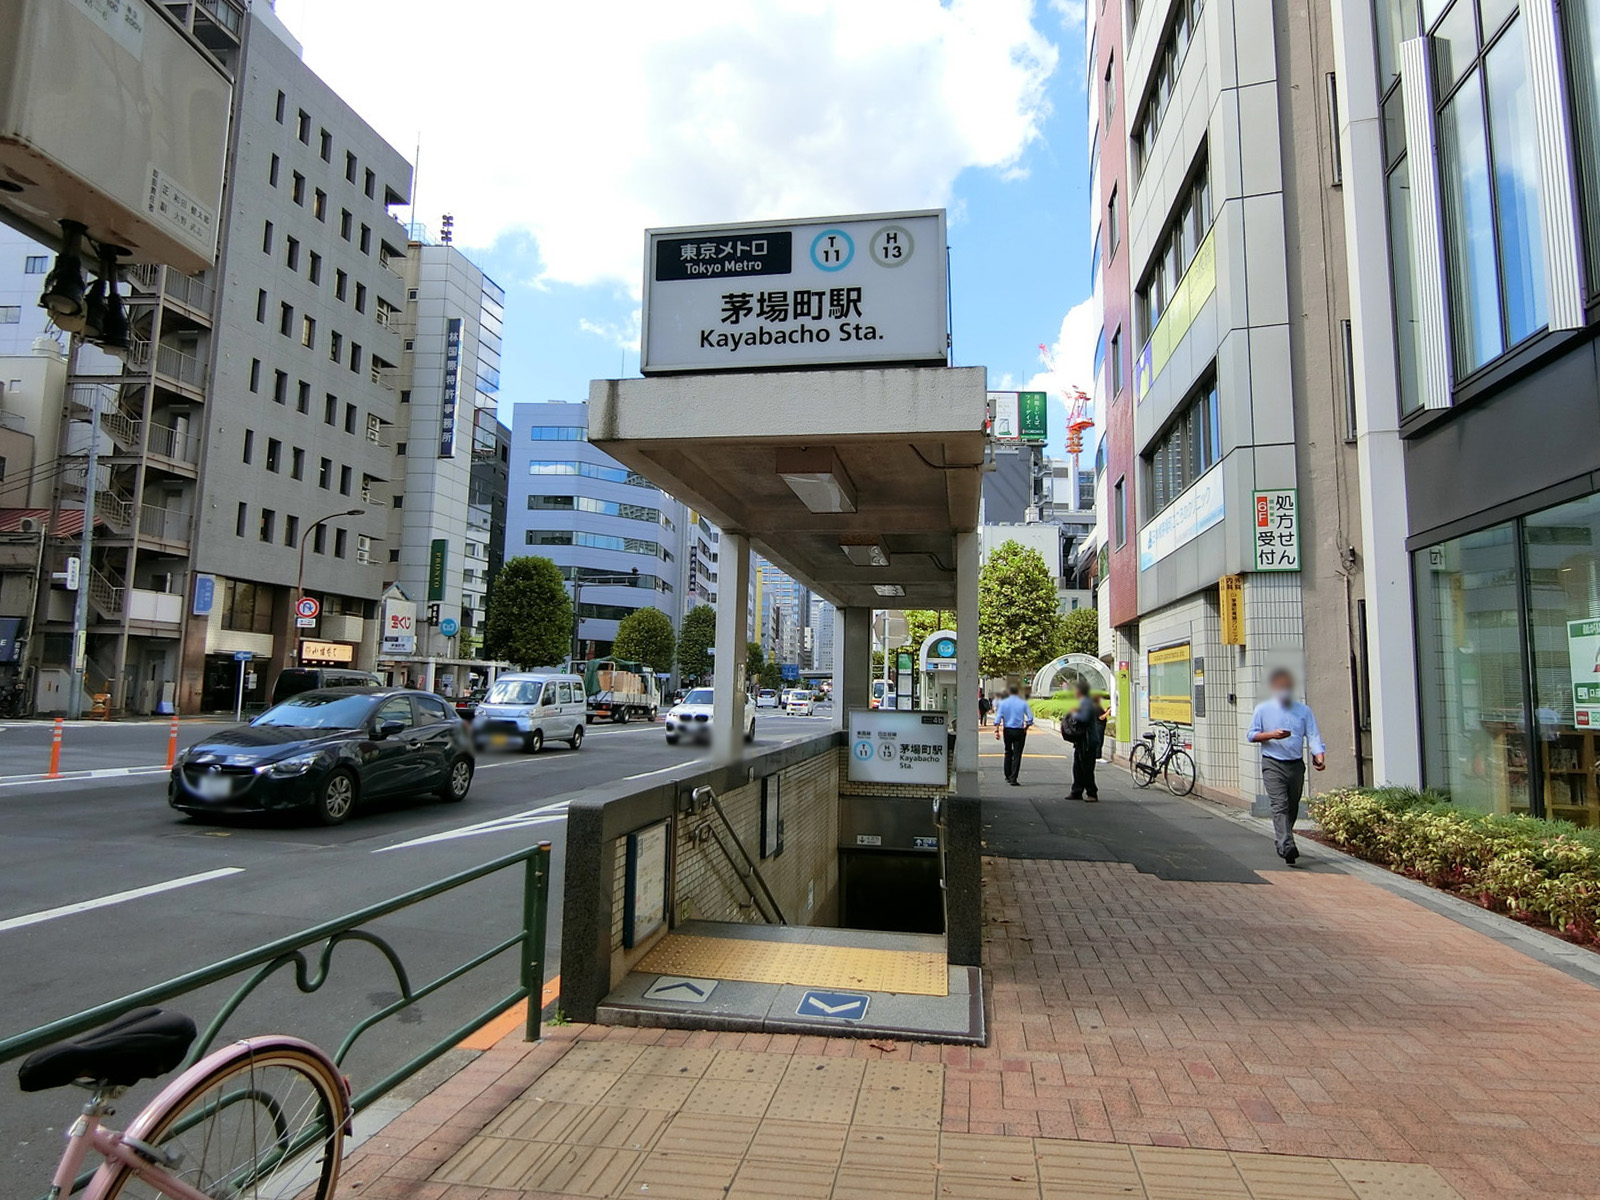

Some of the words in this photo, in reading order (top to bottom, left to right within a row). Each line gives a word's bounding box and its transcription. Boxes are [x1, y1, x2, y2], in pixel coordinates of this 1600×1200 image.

[828, 236, 836, 248] T
[886, 233, 897, 244] H
[680, 239, 768, 261] 東京メトロ
[823, 250, 841, 262] 11
[882, 246, 902, 259] 13
[685, 262, 722, 276] Tokyo
[724, 260, 762, 273] Metro
[720, 287, 863, 325] 茅場町駅
[700, 326, 830, 351] Kayabacho
[839, 322, 884, 342] Sta.
[441, 331, 459, 443] 林国際特許事務所
[1257, 502, 1267, 522] 6F
[1275, 495, 1296, 565] 処方せん
[1257, 531, 1276, 565] 受付
[434, 552, 442, 588] PRONTO
[1226, 577, 1233, 590] 内科
[391, 614, 412, 630] 宝くじ
[899, 743, 943, 756] 茅場町駅
[900, 755, 940, 763] Kayabacho
